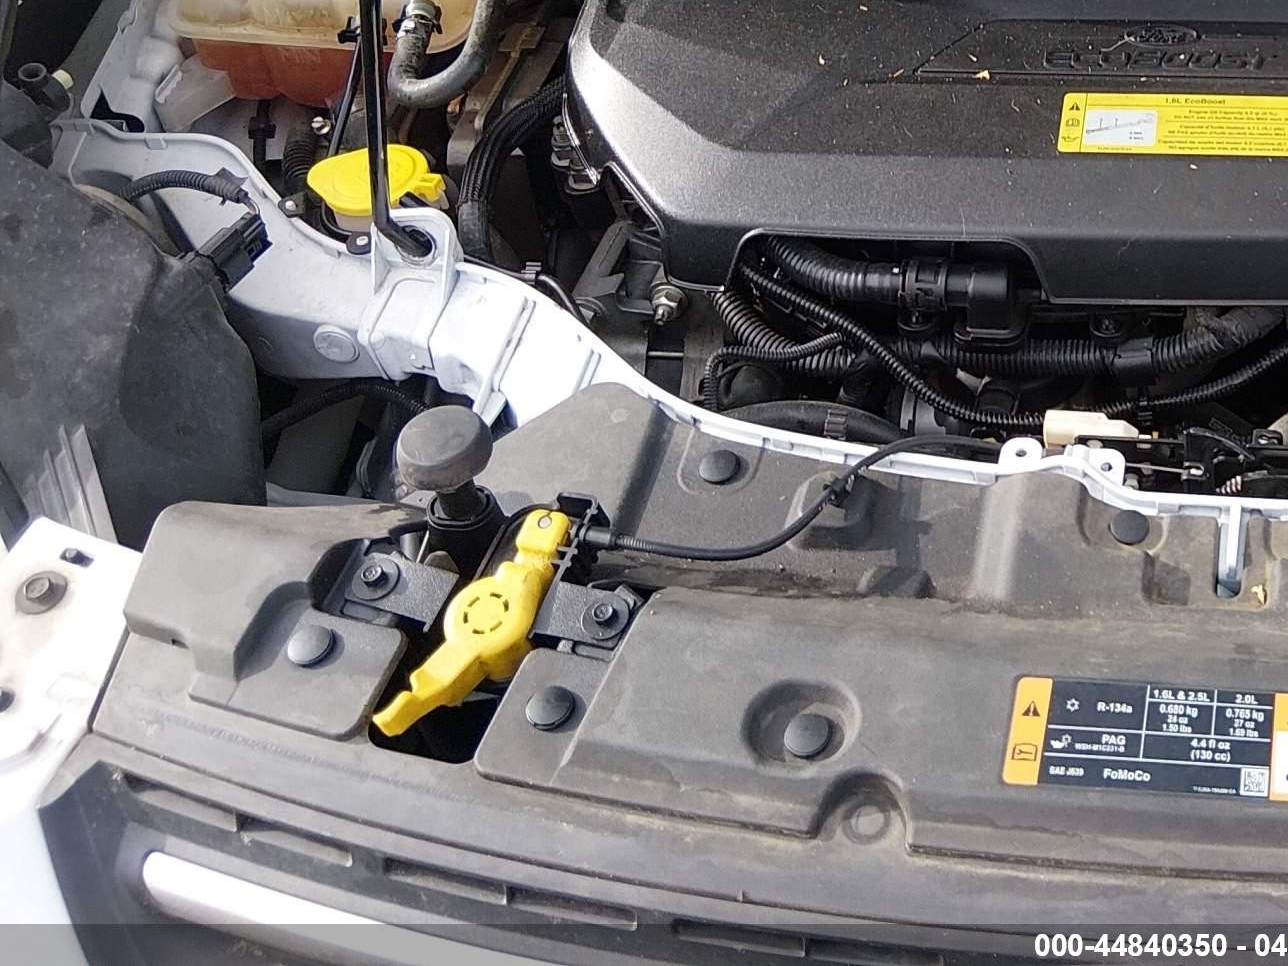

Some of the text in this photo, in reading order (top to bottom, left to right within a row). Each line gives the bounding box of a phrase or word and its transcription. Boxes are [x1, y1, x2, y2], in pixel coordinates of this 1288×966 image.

[1187, 691, 1210, 702] 2.5L
[1235, 693, 1258, 705] 2.0L
[1096, 701, 1133, 714] R-134a
[1186, 705, 1198, 718] kg
[1252, 710, 1264, 722] kg
[1102, 734, 1126, 745] PAG
[1190, 738, 1231, 750] 4.4 fl oz
[1190, 749, 1231, 762] (130 cc)
[1103, 768, 1151, 782] FoMoCo
